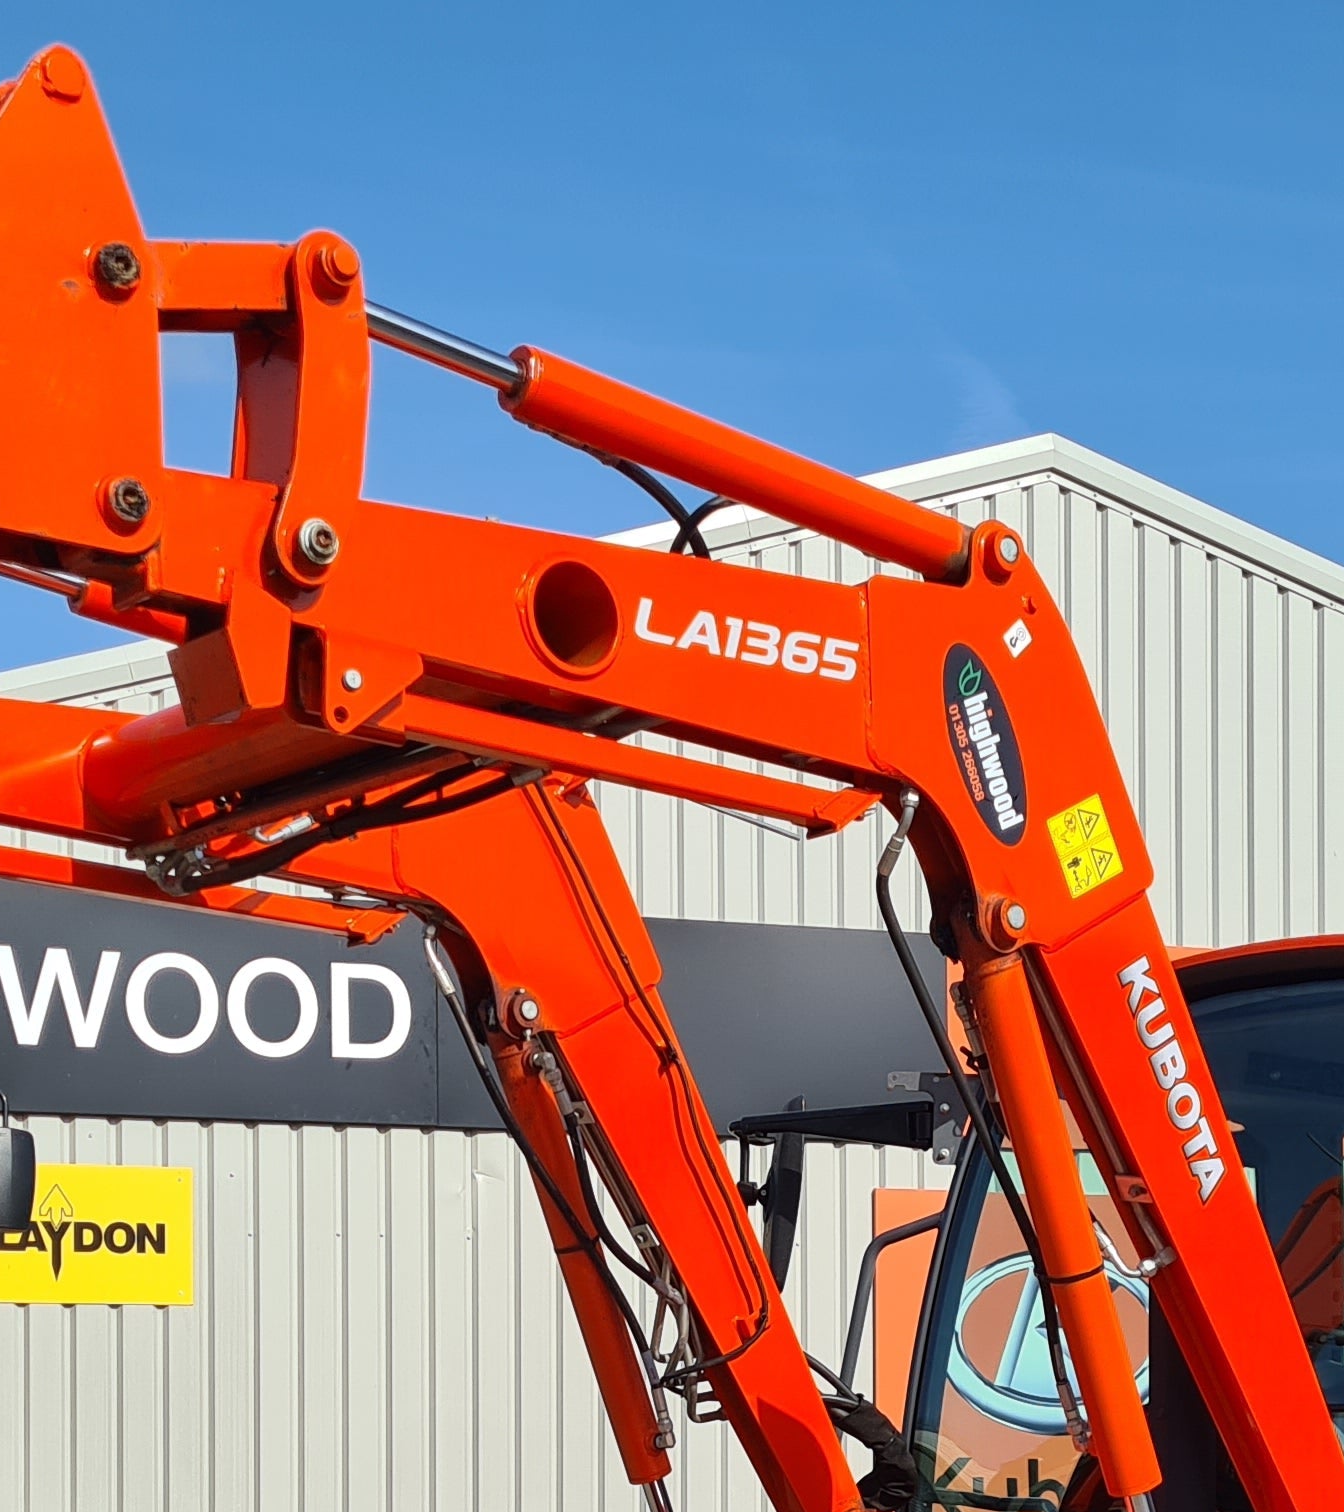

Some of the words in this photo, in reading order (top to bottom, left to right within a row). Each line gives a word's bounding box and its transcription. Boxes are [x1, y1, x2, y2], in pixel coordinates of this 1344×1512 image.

[634, 597, 859, 682] LA1365
[949, 704, 968, 748] 01305
[961, 749, 985, 802] 266058
[964, 692, 1025, 832] highwood
[1117, 954, 1226, 1205] KUBOTA
